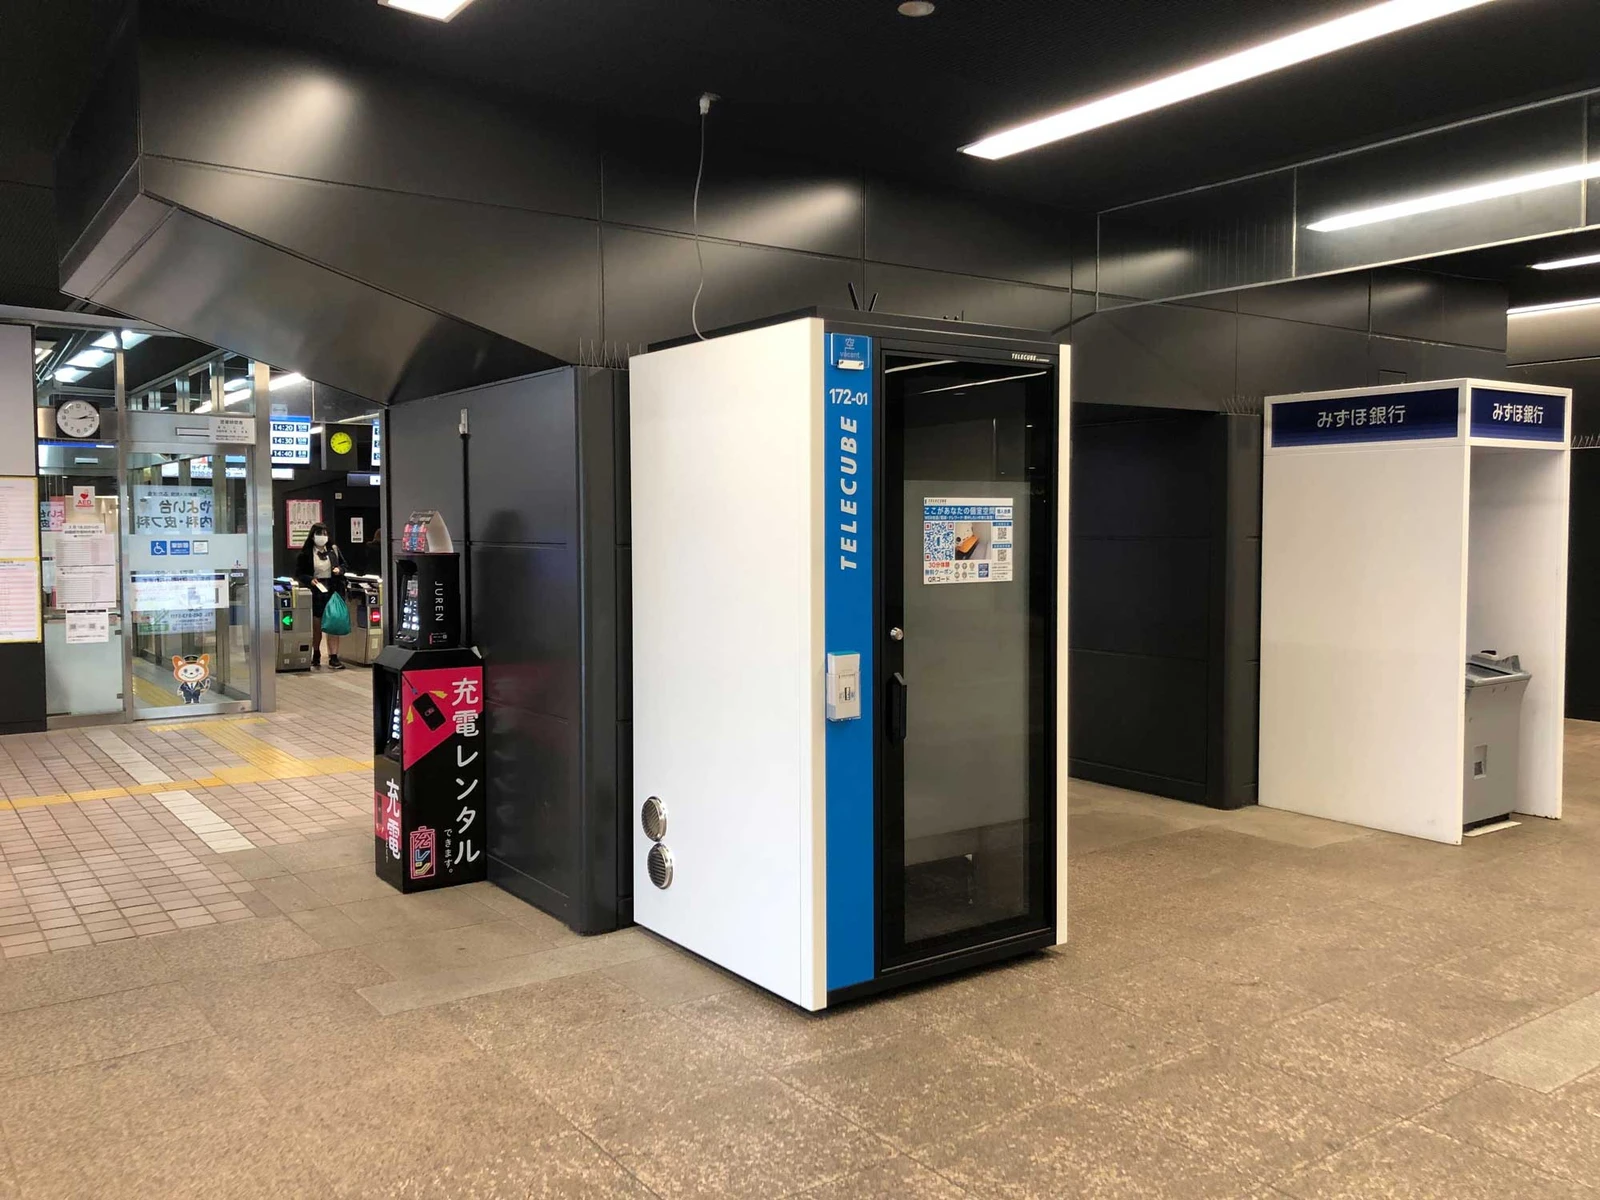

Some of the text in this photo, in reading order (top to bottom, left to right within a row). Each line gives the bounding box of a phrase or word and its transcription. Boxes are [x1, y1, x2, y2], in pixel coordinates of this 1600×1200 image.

[829, 388, 868, 406] 172-01
[1316, 404, 1406, 428] みずほ銀行
[1492, 402, 1544, 425] みずほ銀行
[273, 424, 294, 432] 14:20
[272, 437, 293, 445] 14:30
[272, 450, 293, 458] 14:40
[840, 416, 857, 570] TELECUBE
[370, 596, 376, 604] 2
[434, 580, 444, 622] JUREN
[451, 677, 480, 865] 充電レンタル
[386, 778, 401, 860] 充電
[443, 828, 454, 874] できます。
